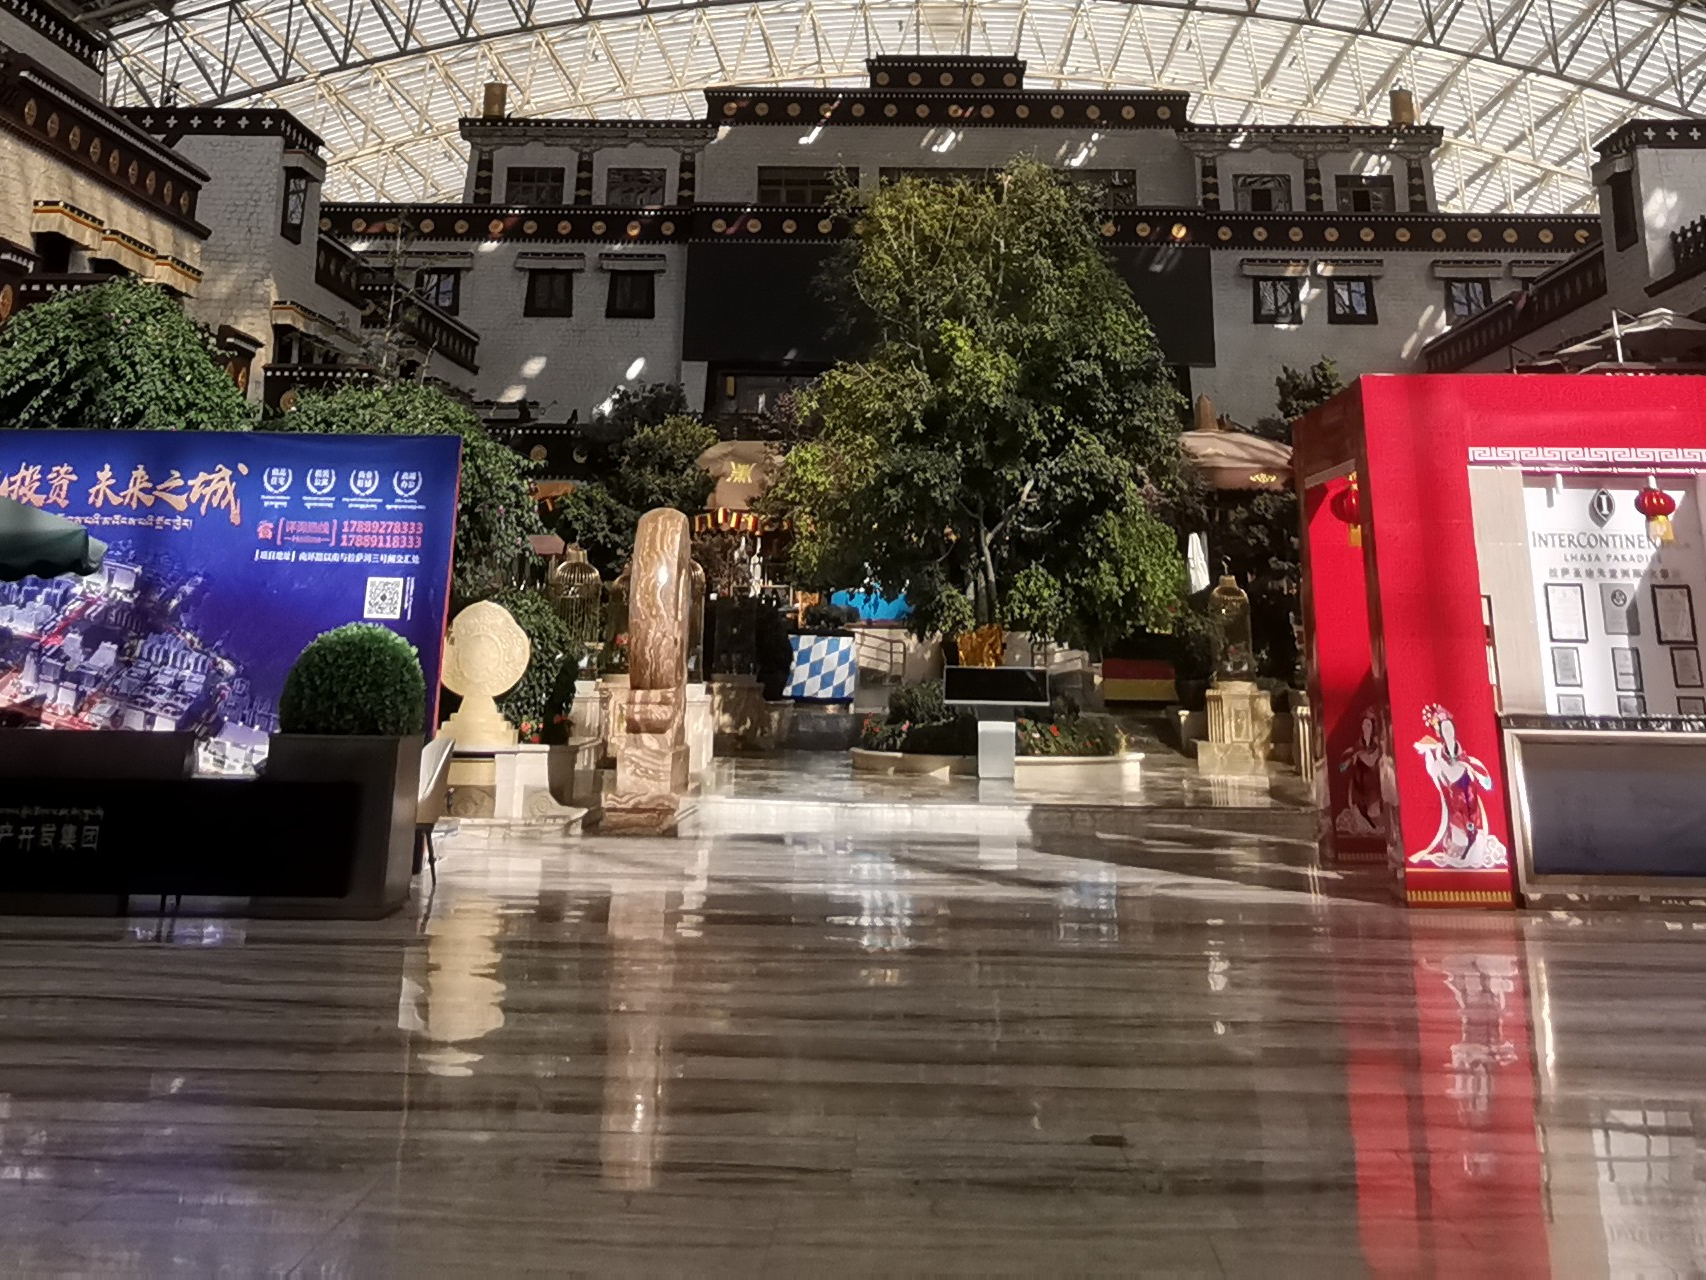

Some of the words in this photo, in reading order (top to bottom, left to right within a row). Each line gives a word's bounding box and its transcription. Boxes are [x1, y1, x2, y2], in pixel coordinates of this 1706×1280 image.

[88, 462, 249, 526] 未来之城
[1564, 553, 1601, 563] LHASA
